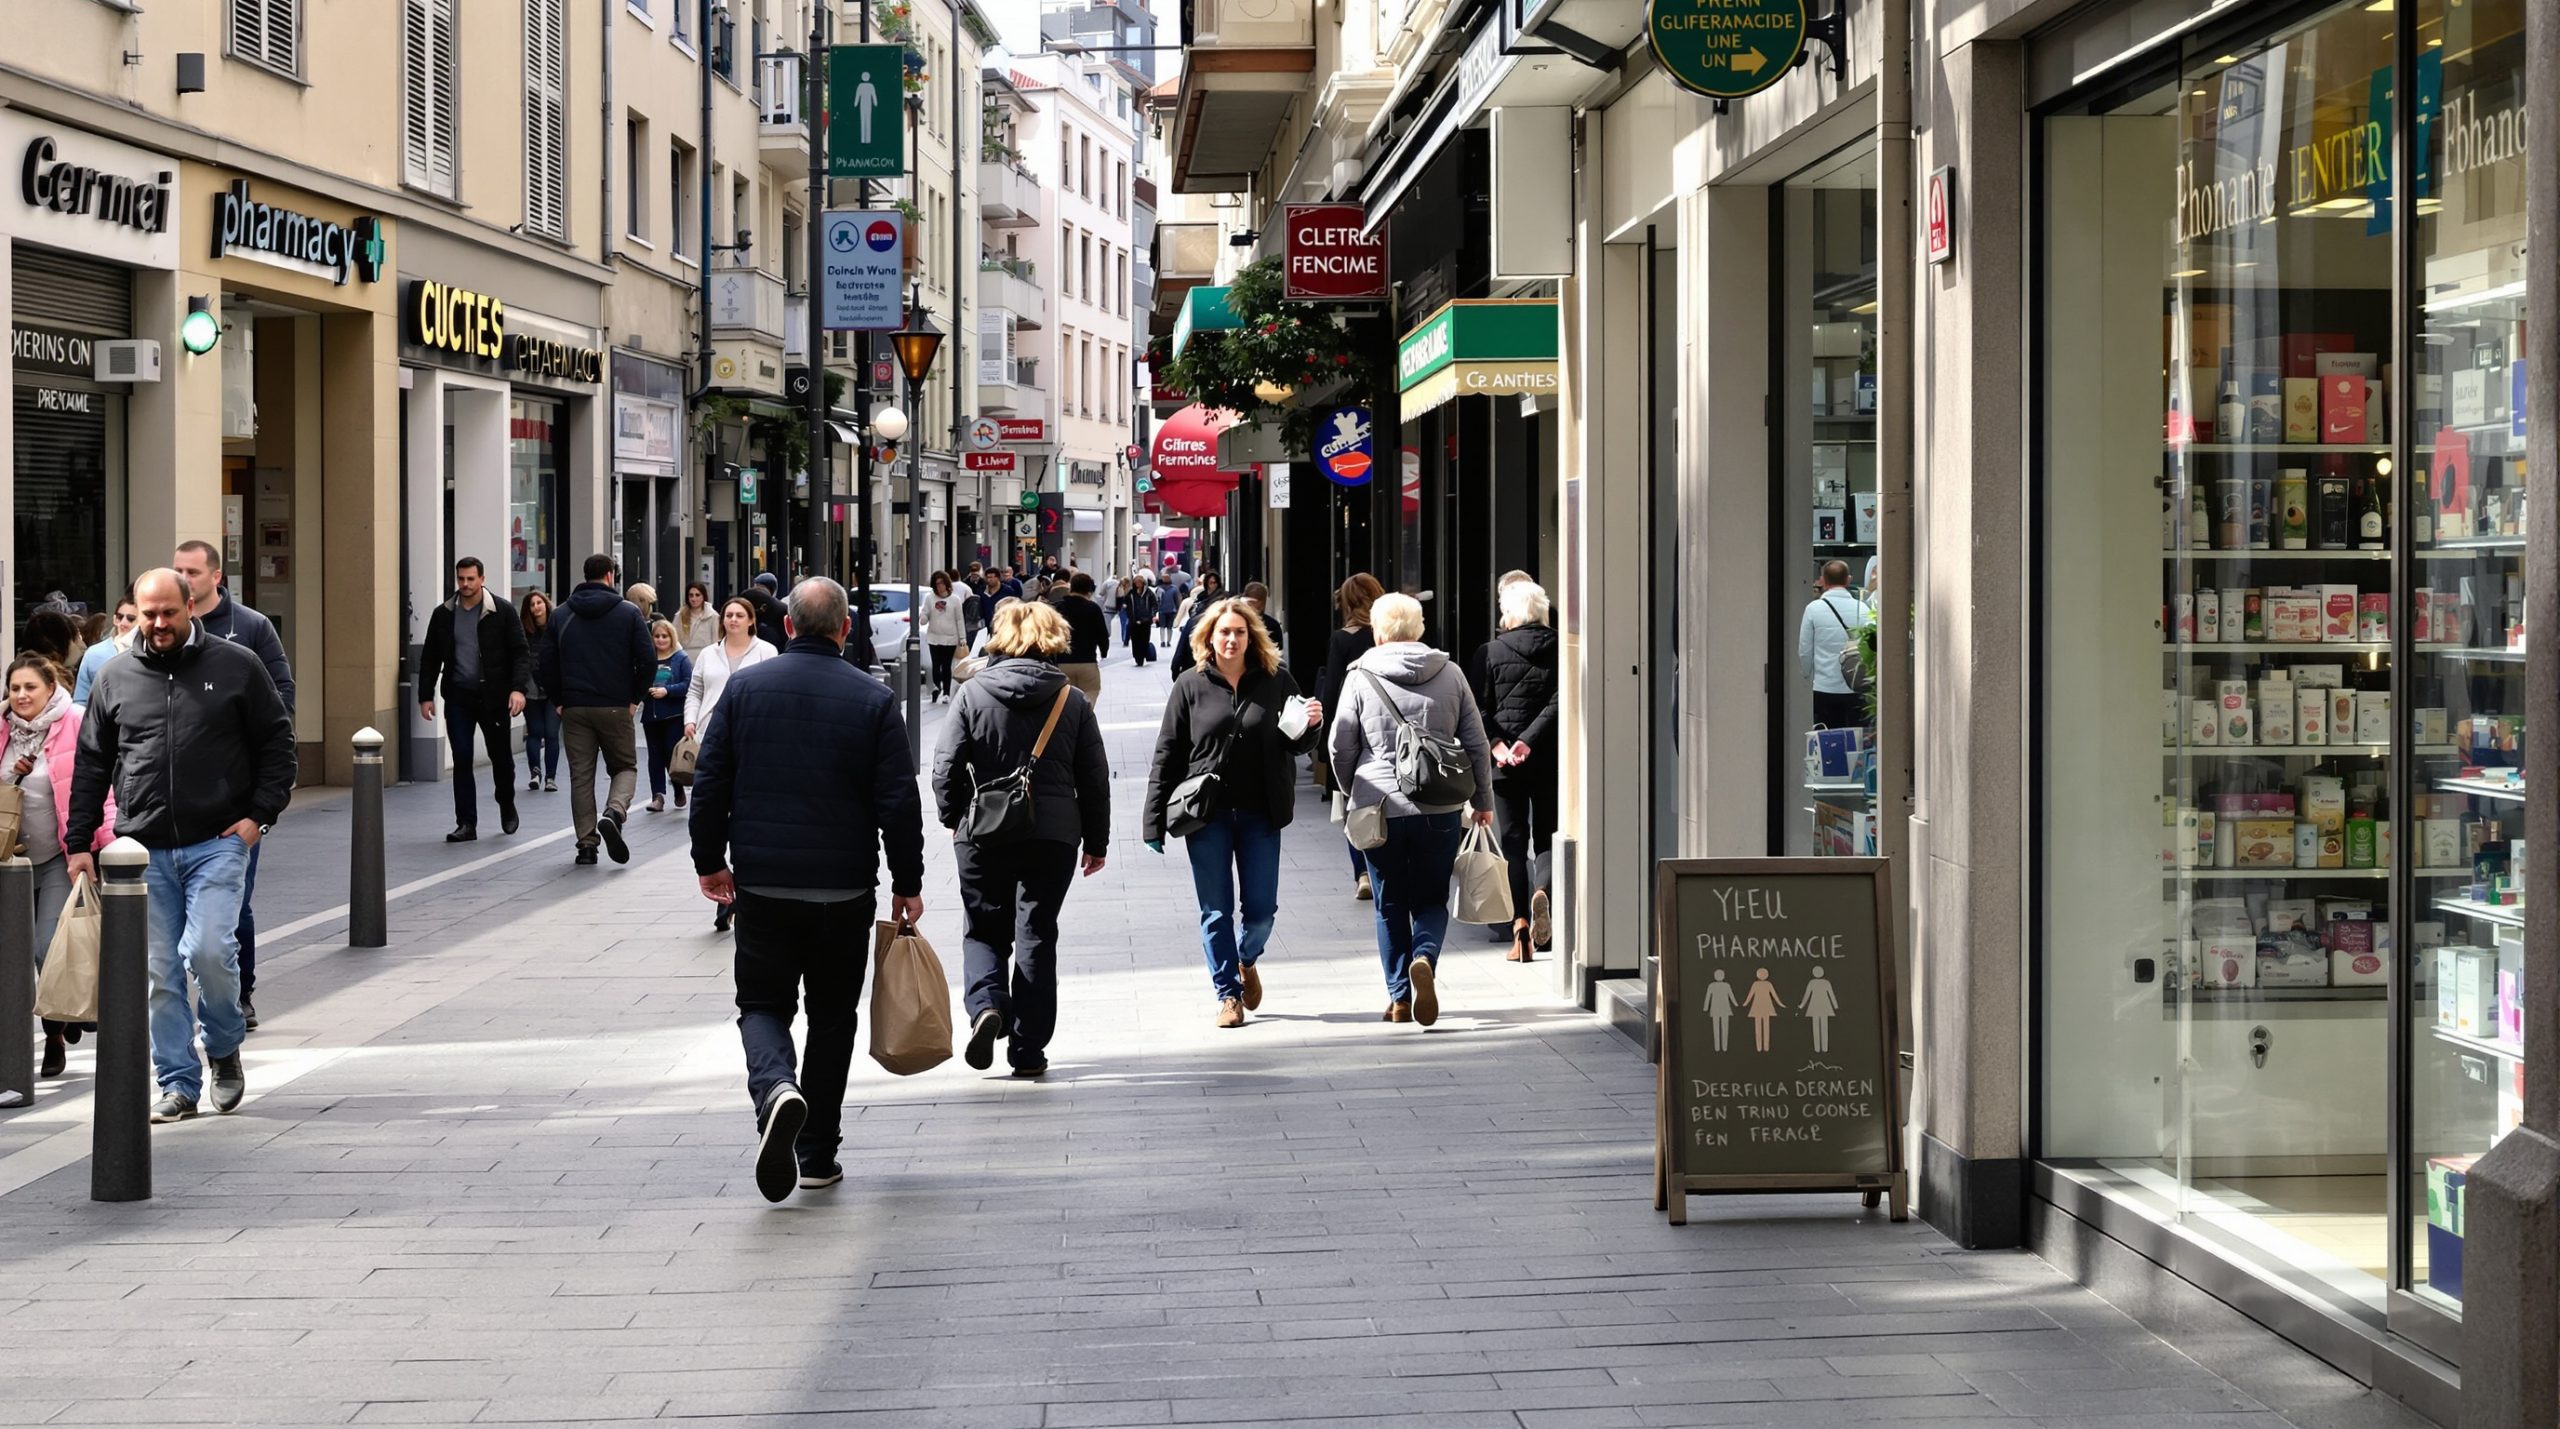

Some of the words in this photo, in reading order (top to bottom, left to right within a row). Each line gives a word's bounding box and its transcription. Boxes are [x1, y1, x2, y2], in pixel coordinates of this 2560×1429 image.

[1707, 34, 1743, 48] UNE
[1701, 53, 1727, 68] UN
[211, 179, 357, 287] pharmacy
[1293, 256, 1378, 274] FENCIME
[68, 338, 91, 366] ON
[1795, 1079, 1873, 1097] DERMEN
[1691, 1105, 1727, 1122] BEN
[1802, 1102, 1872, 1118] COONSE
